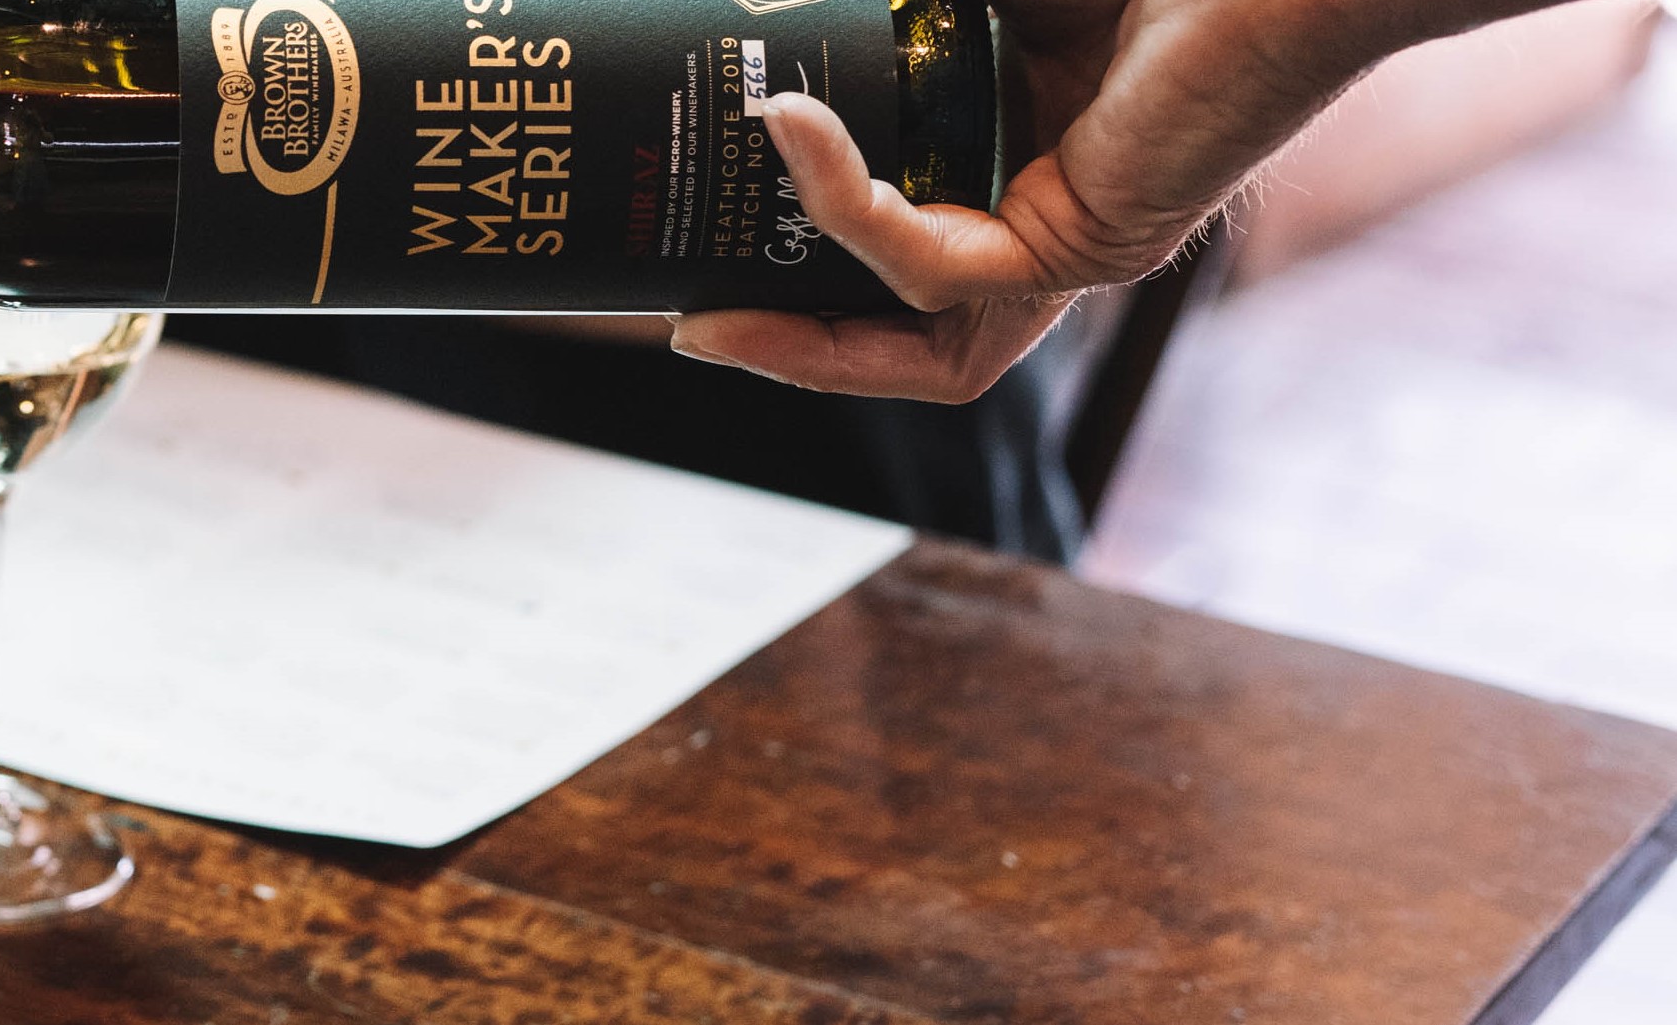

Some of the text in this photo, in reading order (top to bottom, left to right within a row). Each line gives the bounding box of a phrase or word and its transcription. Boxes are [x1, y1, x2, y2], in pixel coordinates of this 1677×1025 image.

[221, 23, 235, 61] 1889
[261, 36, 287, 141] BROWN
[283, 21, 309, 157] BROTHERS
[310, 33, 320, 145] FAMILY WINEMAKERS
[324, 17, 353, 162] MILAWA AUSTRALIA
[742, 55, 766, 100] 566
[407, 79, 464, 255] WINE
[516, 37, 572, 256] SERIES
[627, 144, 662, 258] SHIRAZ
[661, 89, 683, 258] INSPIRED BY OUR MICRO-WINERY,
[677, 50, 697, 257] HAND SELECTED BY OUR WINEMAKERS.
[713, 36, 740, 257] HEATHCOTE 2019
[736, 183, 761, 257] BATCH
